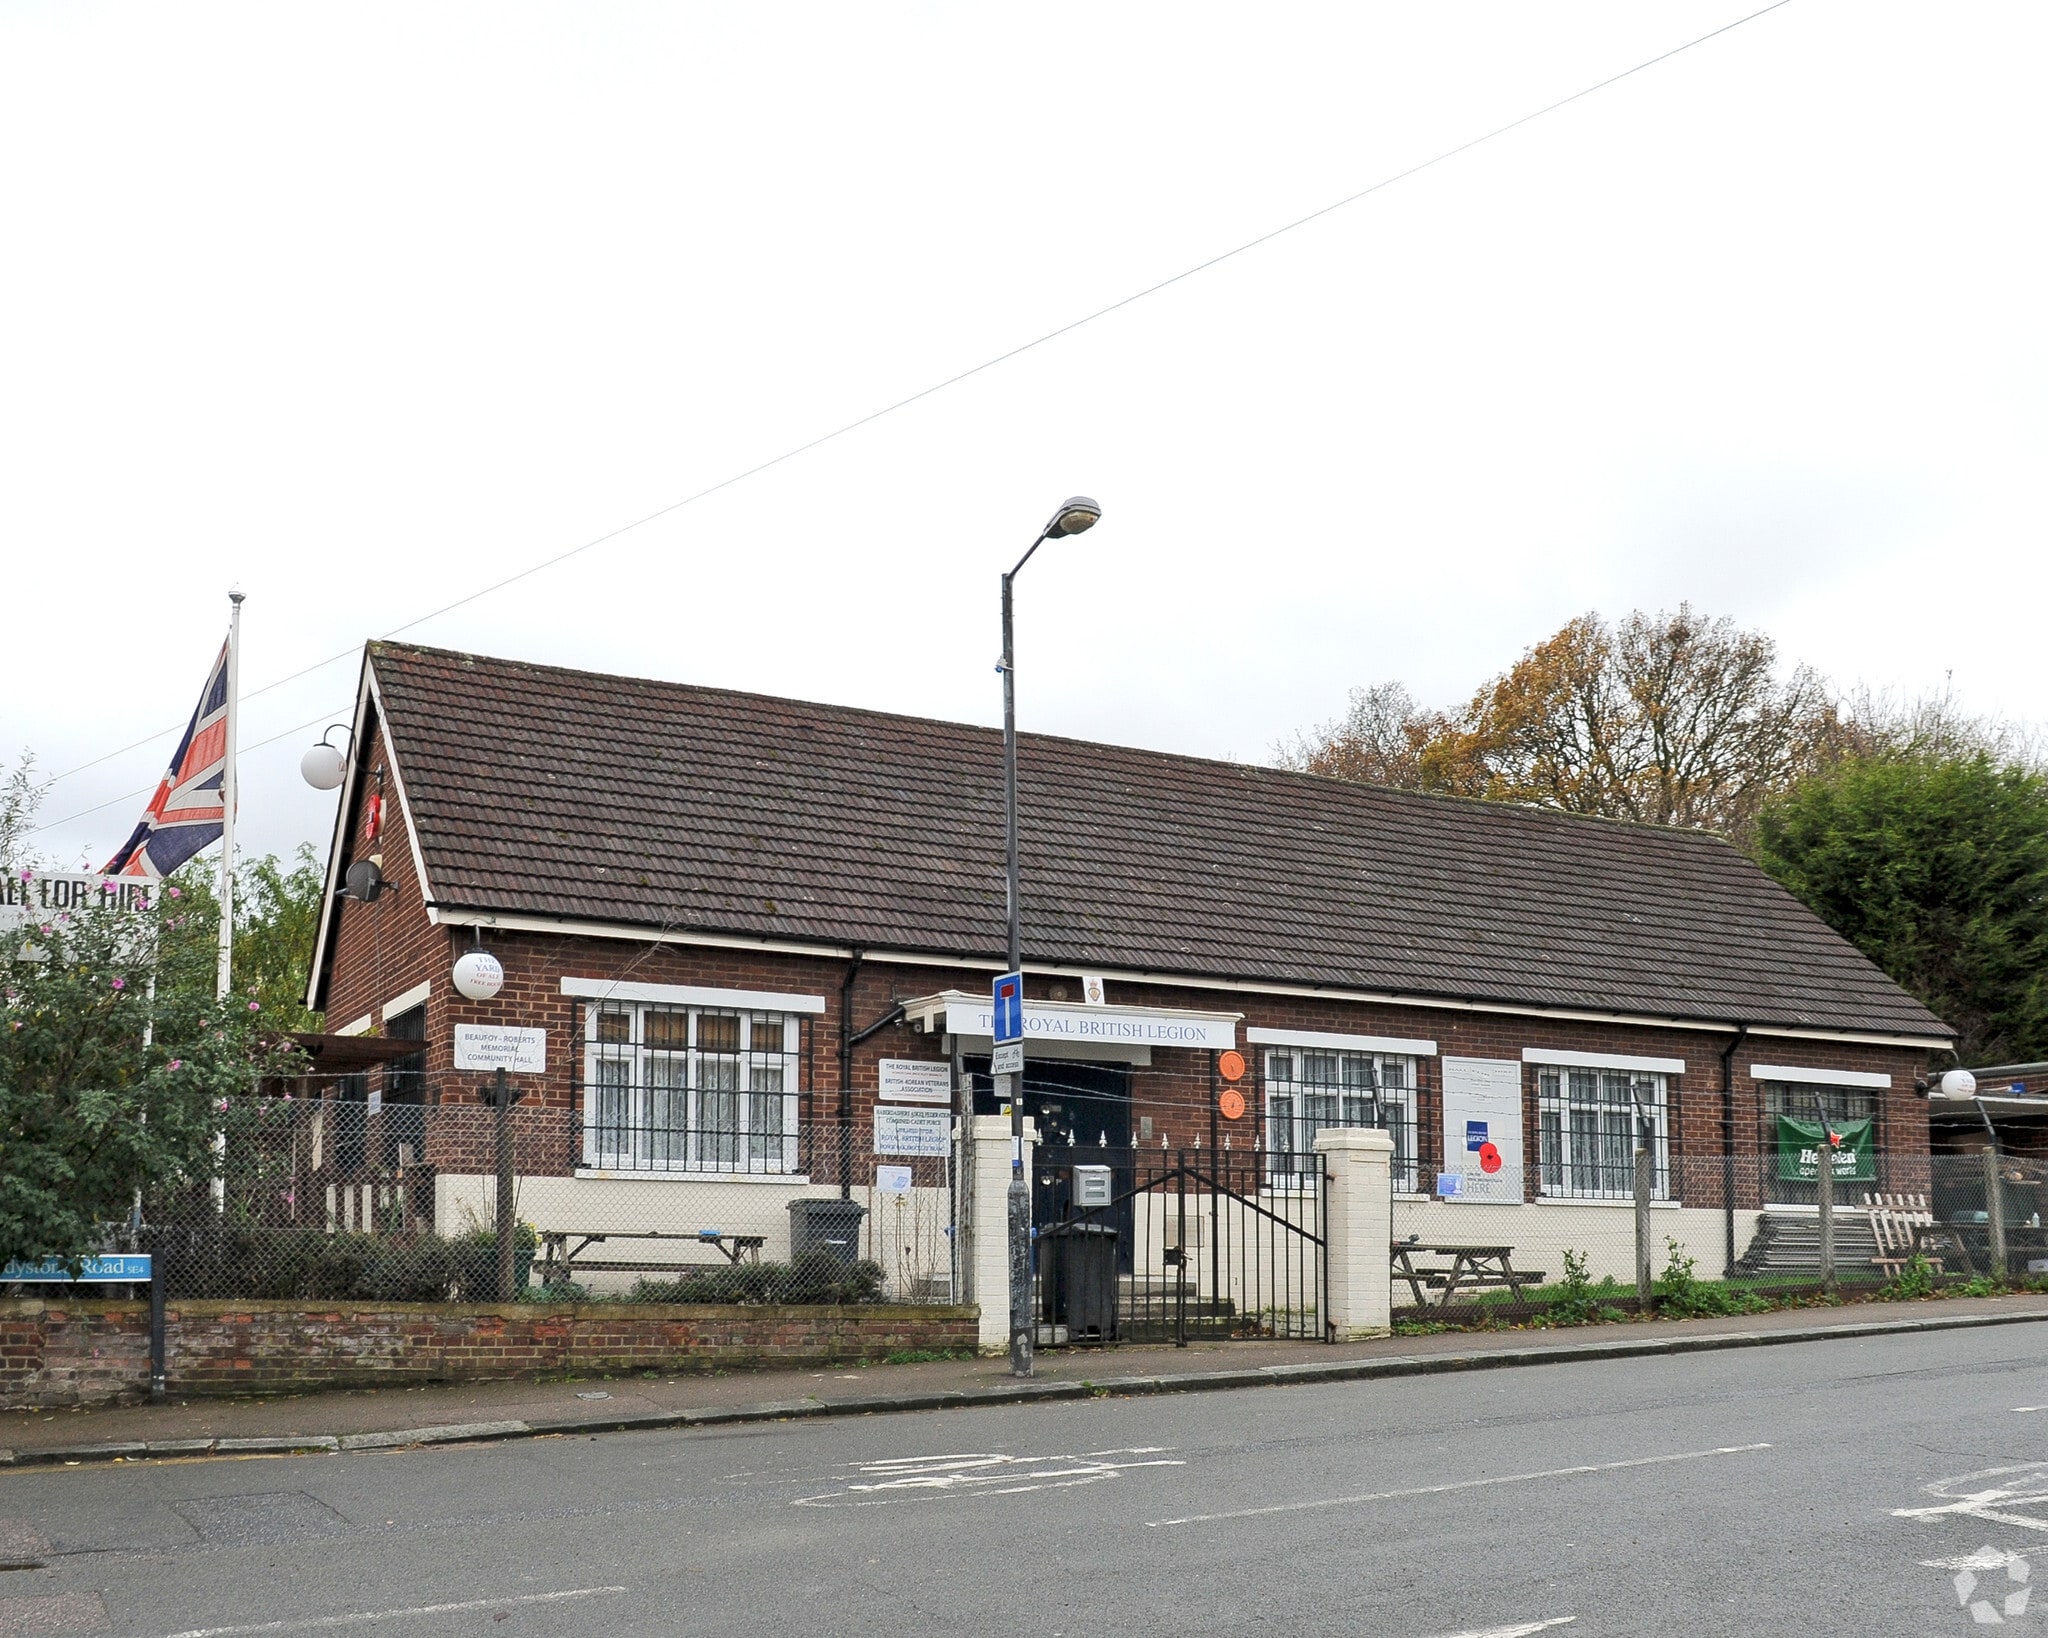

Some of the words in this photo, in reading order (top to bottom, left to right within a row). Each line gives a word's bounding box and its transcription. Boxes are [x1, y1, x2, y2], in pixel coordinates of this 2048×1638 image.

[41, 879, 88, 909] FOR
[102, 882, 154, 911] HIRE
[475, 964, 501, 974] YARD
[1022, 1017, 1075, 1034] ROYAL
[1079, 1020, 1142, 1037] BRITISH
[1148, 1025, 1207, 1040] LEGION
[464, 1033, 498, 1042] BEAUFOY
[503, 1035, 536, 1044] ROBERTS
[480, 1044, 520, 1053] MEMORIAL
[467, 1053, 513, 1062] COMMUNITY
[514, 1056, 533, 1064] HALL
[925, 1080, 950, 1088] VETERANS
[901, 1086, 933, 1094] ASSOCIATION
[80, 1258, 125, 1274] Road
[127, 1265, 144, 1274] SE4
